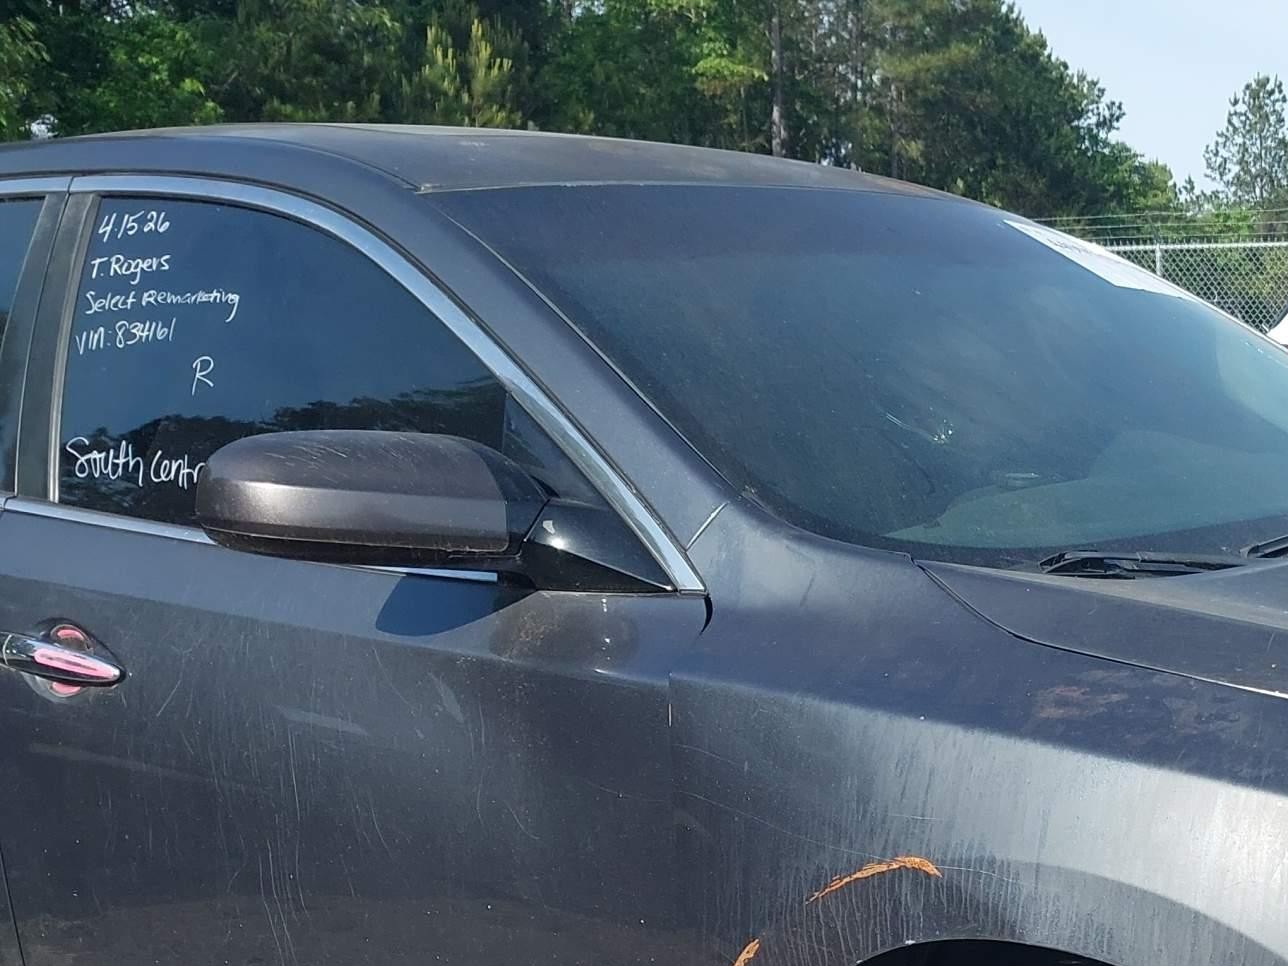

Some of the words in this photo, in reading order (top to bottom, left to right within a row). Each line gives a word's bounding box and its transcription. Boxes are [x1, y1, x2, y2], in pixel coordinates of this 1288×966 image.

[110, 254, 172, 285] Rogers
[85, 291, 136, 314] Select
[192, 355, 214, 396] R
[65, 436, 144, 487] South
